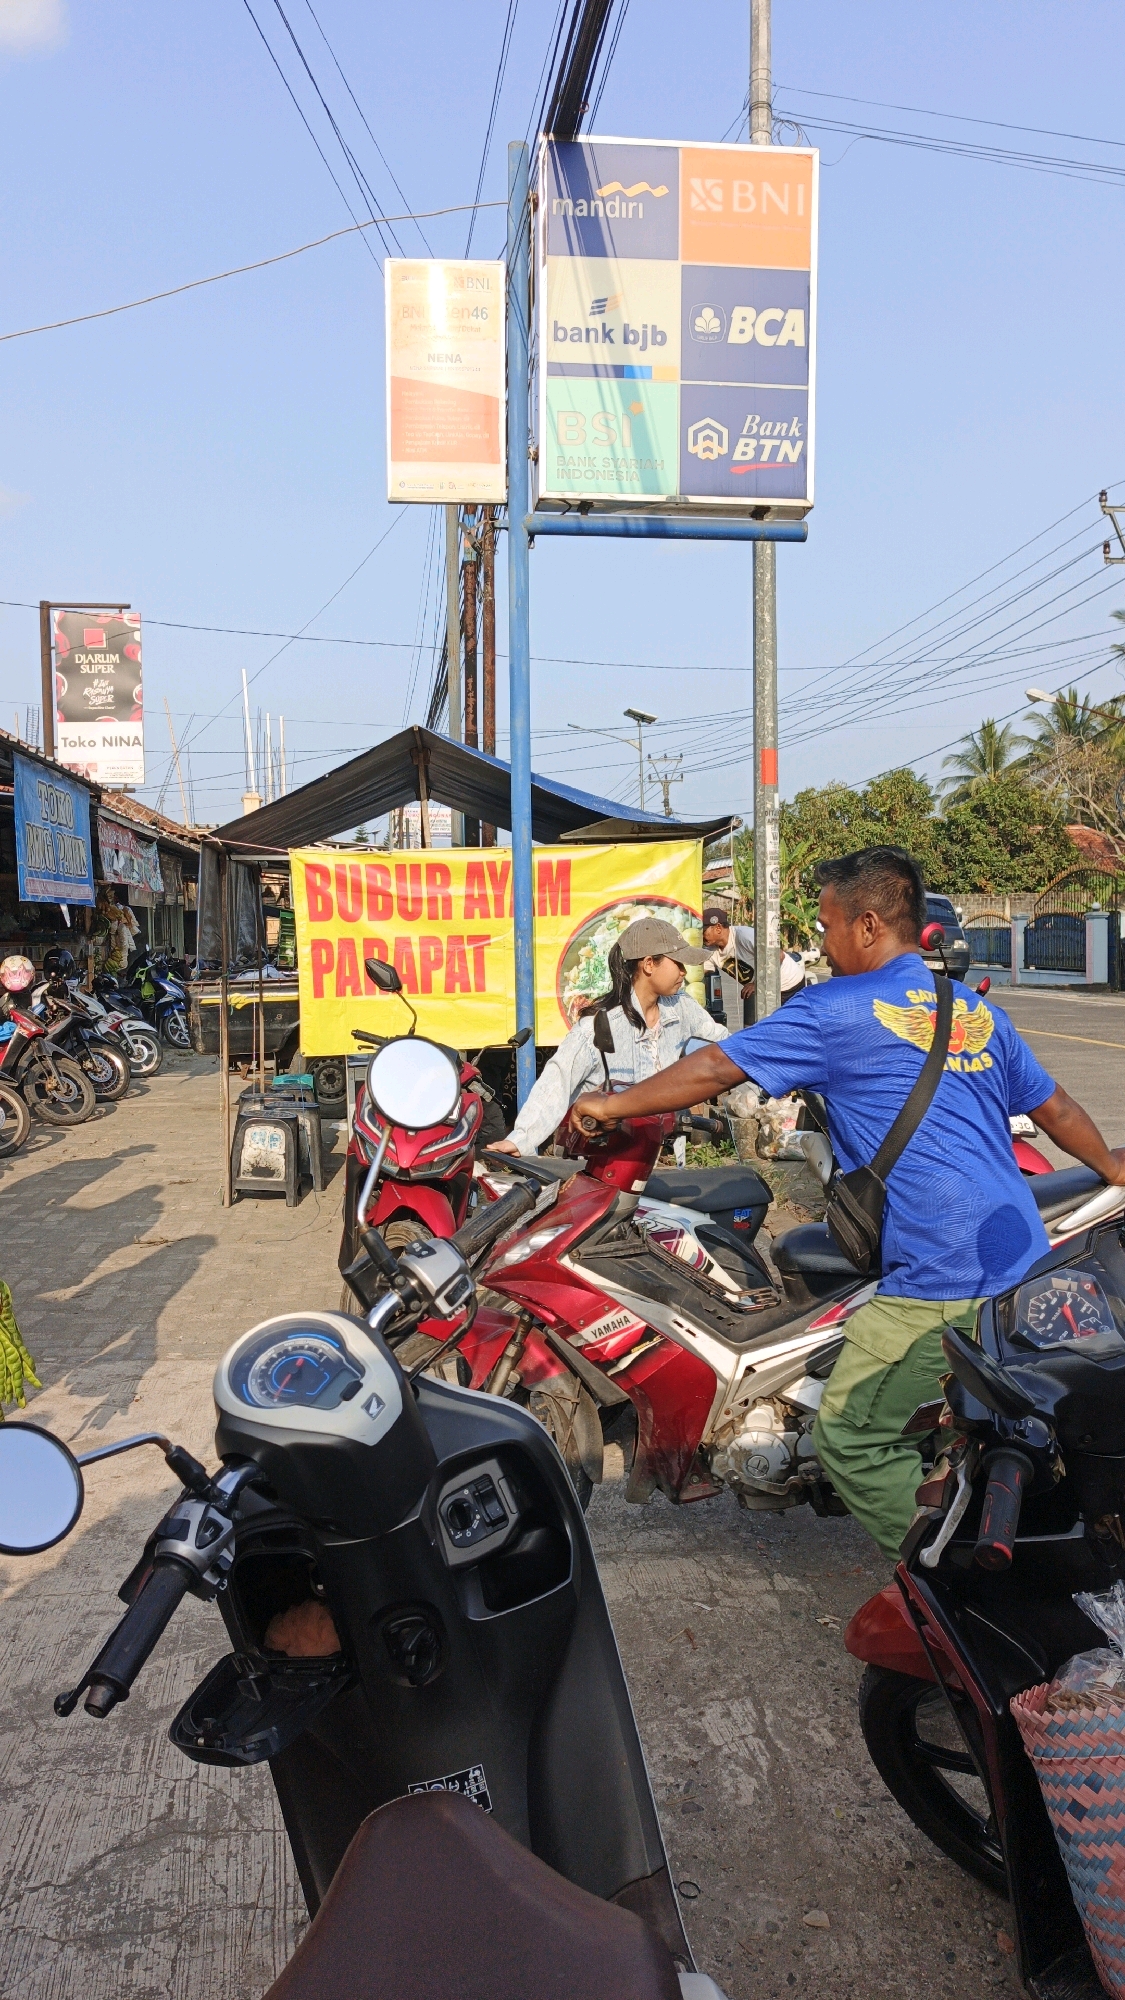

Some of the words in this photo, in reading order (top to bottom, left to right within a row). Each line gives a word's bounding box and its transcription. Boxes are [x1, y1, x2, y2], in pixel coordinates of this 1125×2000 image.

[552, 196, 643, 219] mandiri
[733, 180, 804, 216] BNI
[466, 277, 490, 290] BNI
[402, 305, 425, 319] BNI
[553, 321, 615, 344] bank
[623, 323, 667, 351] bjb
[727, 306, 806, 347] BCA
[427, 353, 463, 364] NENA
[556, 411, 632, 448] BSI
[740, 414, 803, 438] Bank
[732, 438, 803, 463] BTN
[556, 456, 597, 468] BANK
[602, 457, 665, 471] SYARIAH
[556, 468, 640, 482] INDONESIA
[75, 653, 120, 664] DJARUM
[80, 664, 116, 674] SUPER
[61, 735, 97, 748] Toko
[102, 735, 142, 747] NINA
[37, 779, 74, 831] TOKO
[304, 863, 453, 923] BUBUR
[463, 859, 571, 919] AYM
[734, 1209, 752, 1217] EAT
[591, 1315, 631, 1339] YAMAHA
